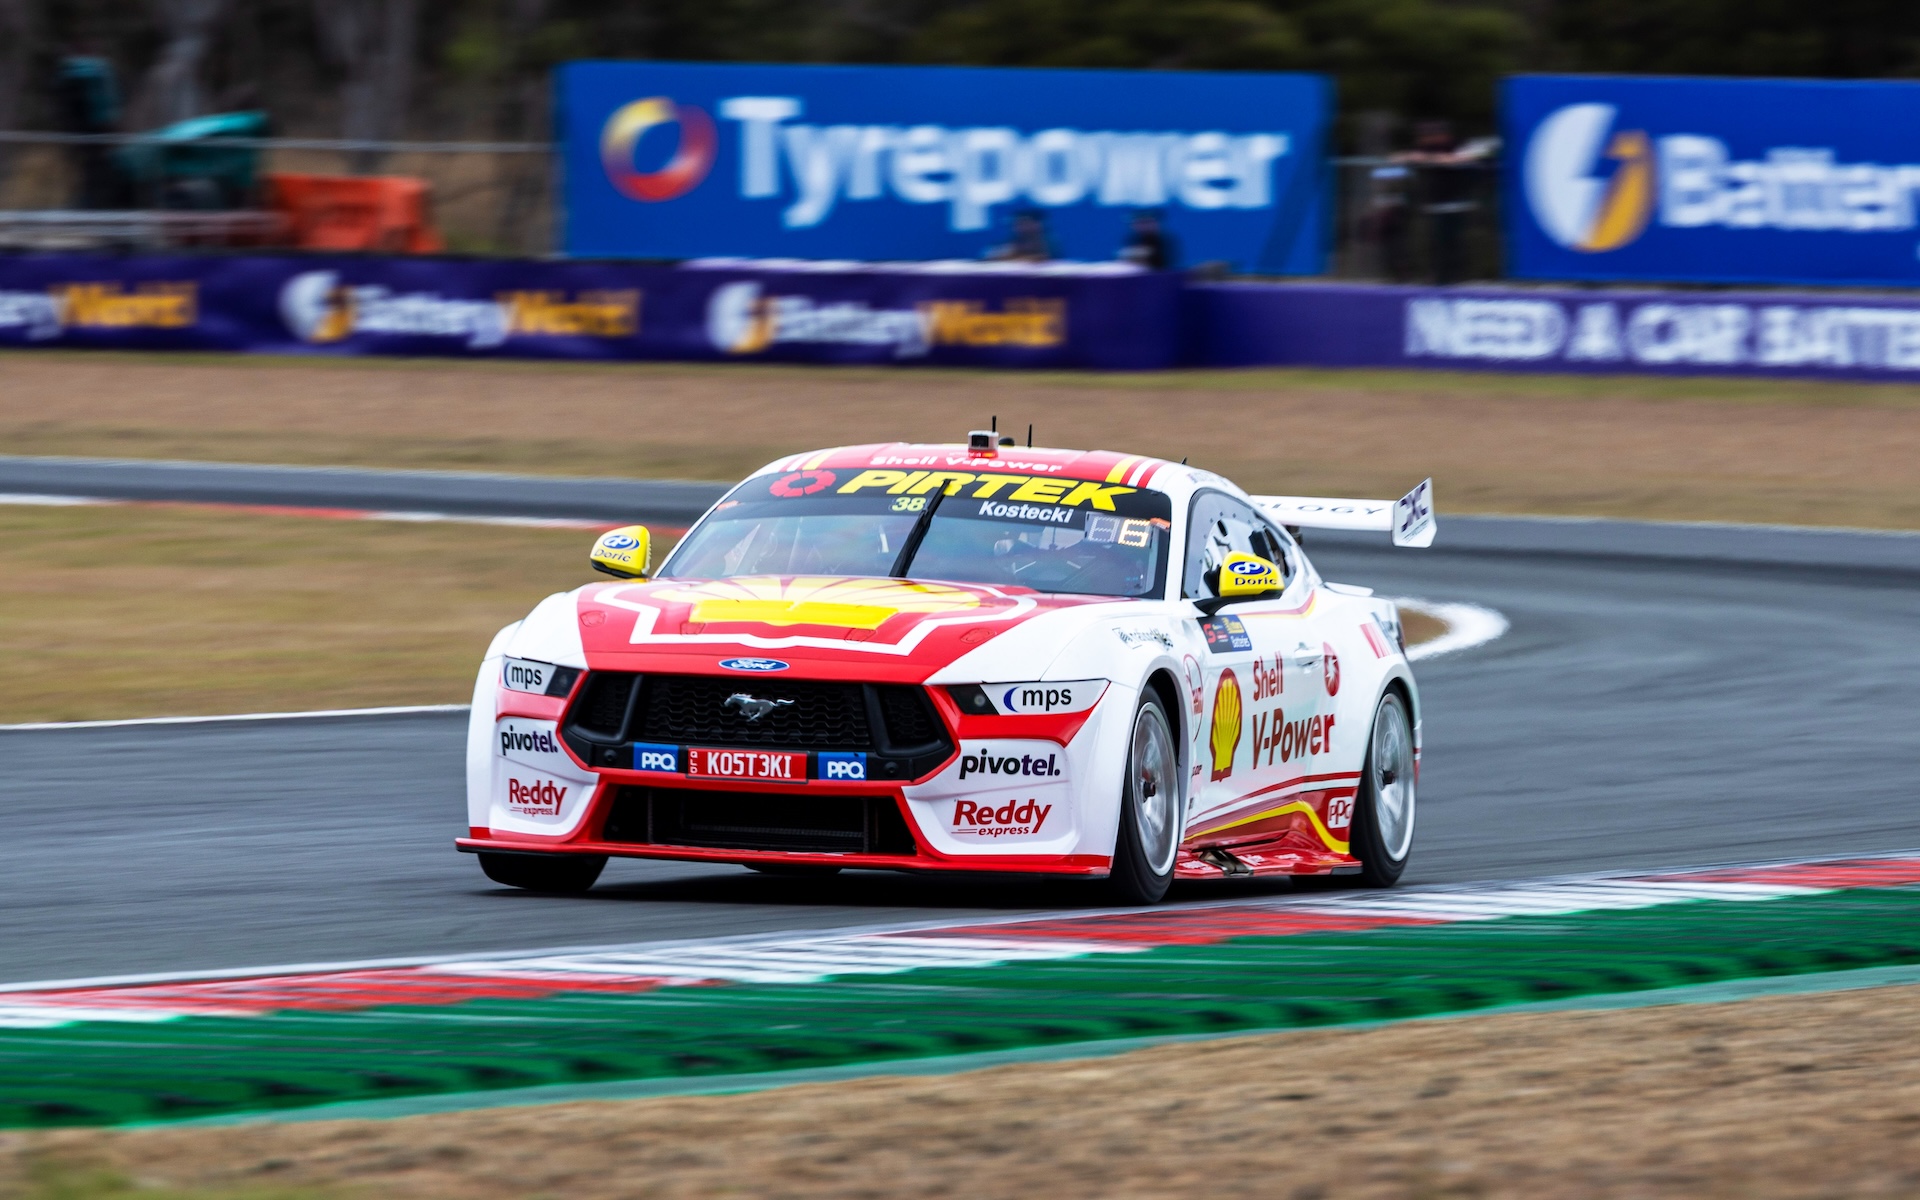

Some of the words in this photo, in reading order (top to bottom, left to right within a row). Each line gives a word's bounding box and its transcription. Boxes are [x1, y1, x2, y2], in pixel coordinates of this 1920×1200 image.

[720, 96, 1292, 231] Tyrepower
[1658, 134, 1920, 233] Batter
[1405, 301, 1567, 360] NEED
[1566, 304, 1624, 362] A
[1626, 305, 1753, 365] CAR
[869, 456, 938, 466] Shell
[945, 457, 1063, 473] V-Power
[836, 470, 1138, 512] PIRTEK
[891, 497, 927, 512] 38
[978, 501, 1074, 524] Kostecki
[594, 548, 631, 563] Doric
[1235, 577, 1277, 586] Doric
[731, 658, 777, 670] Ford
[1253, 651, 1283, 701] Shell
[511, 665, 543, 690] mps
[1022, 688, 1072, 712] mps
[501, 724, 558, 756] pivotel.
[1252, 707, 1335, 770] V-Power
[641, 752, 676, 771] PPQ
[827, 761, 865, 779] PPQ
[959, 748, 1061, 780] pivotel.
[509, 778, 567, 816] Reddy
[523, 807, 554, 817] express
[953, 798, 1052, 834] Reddy
[978, 827, 1029, 838] express
